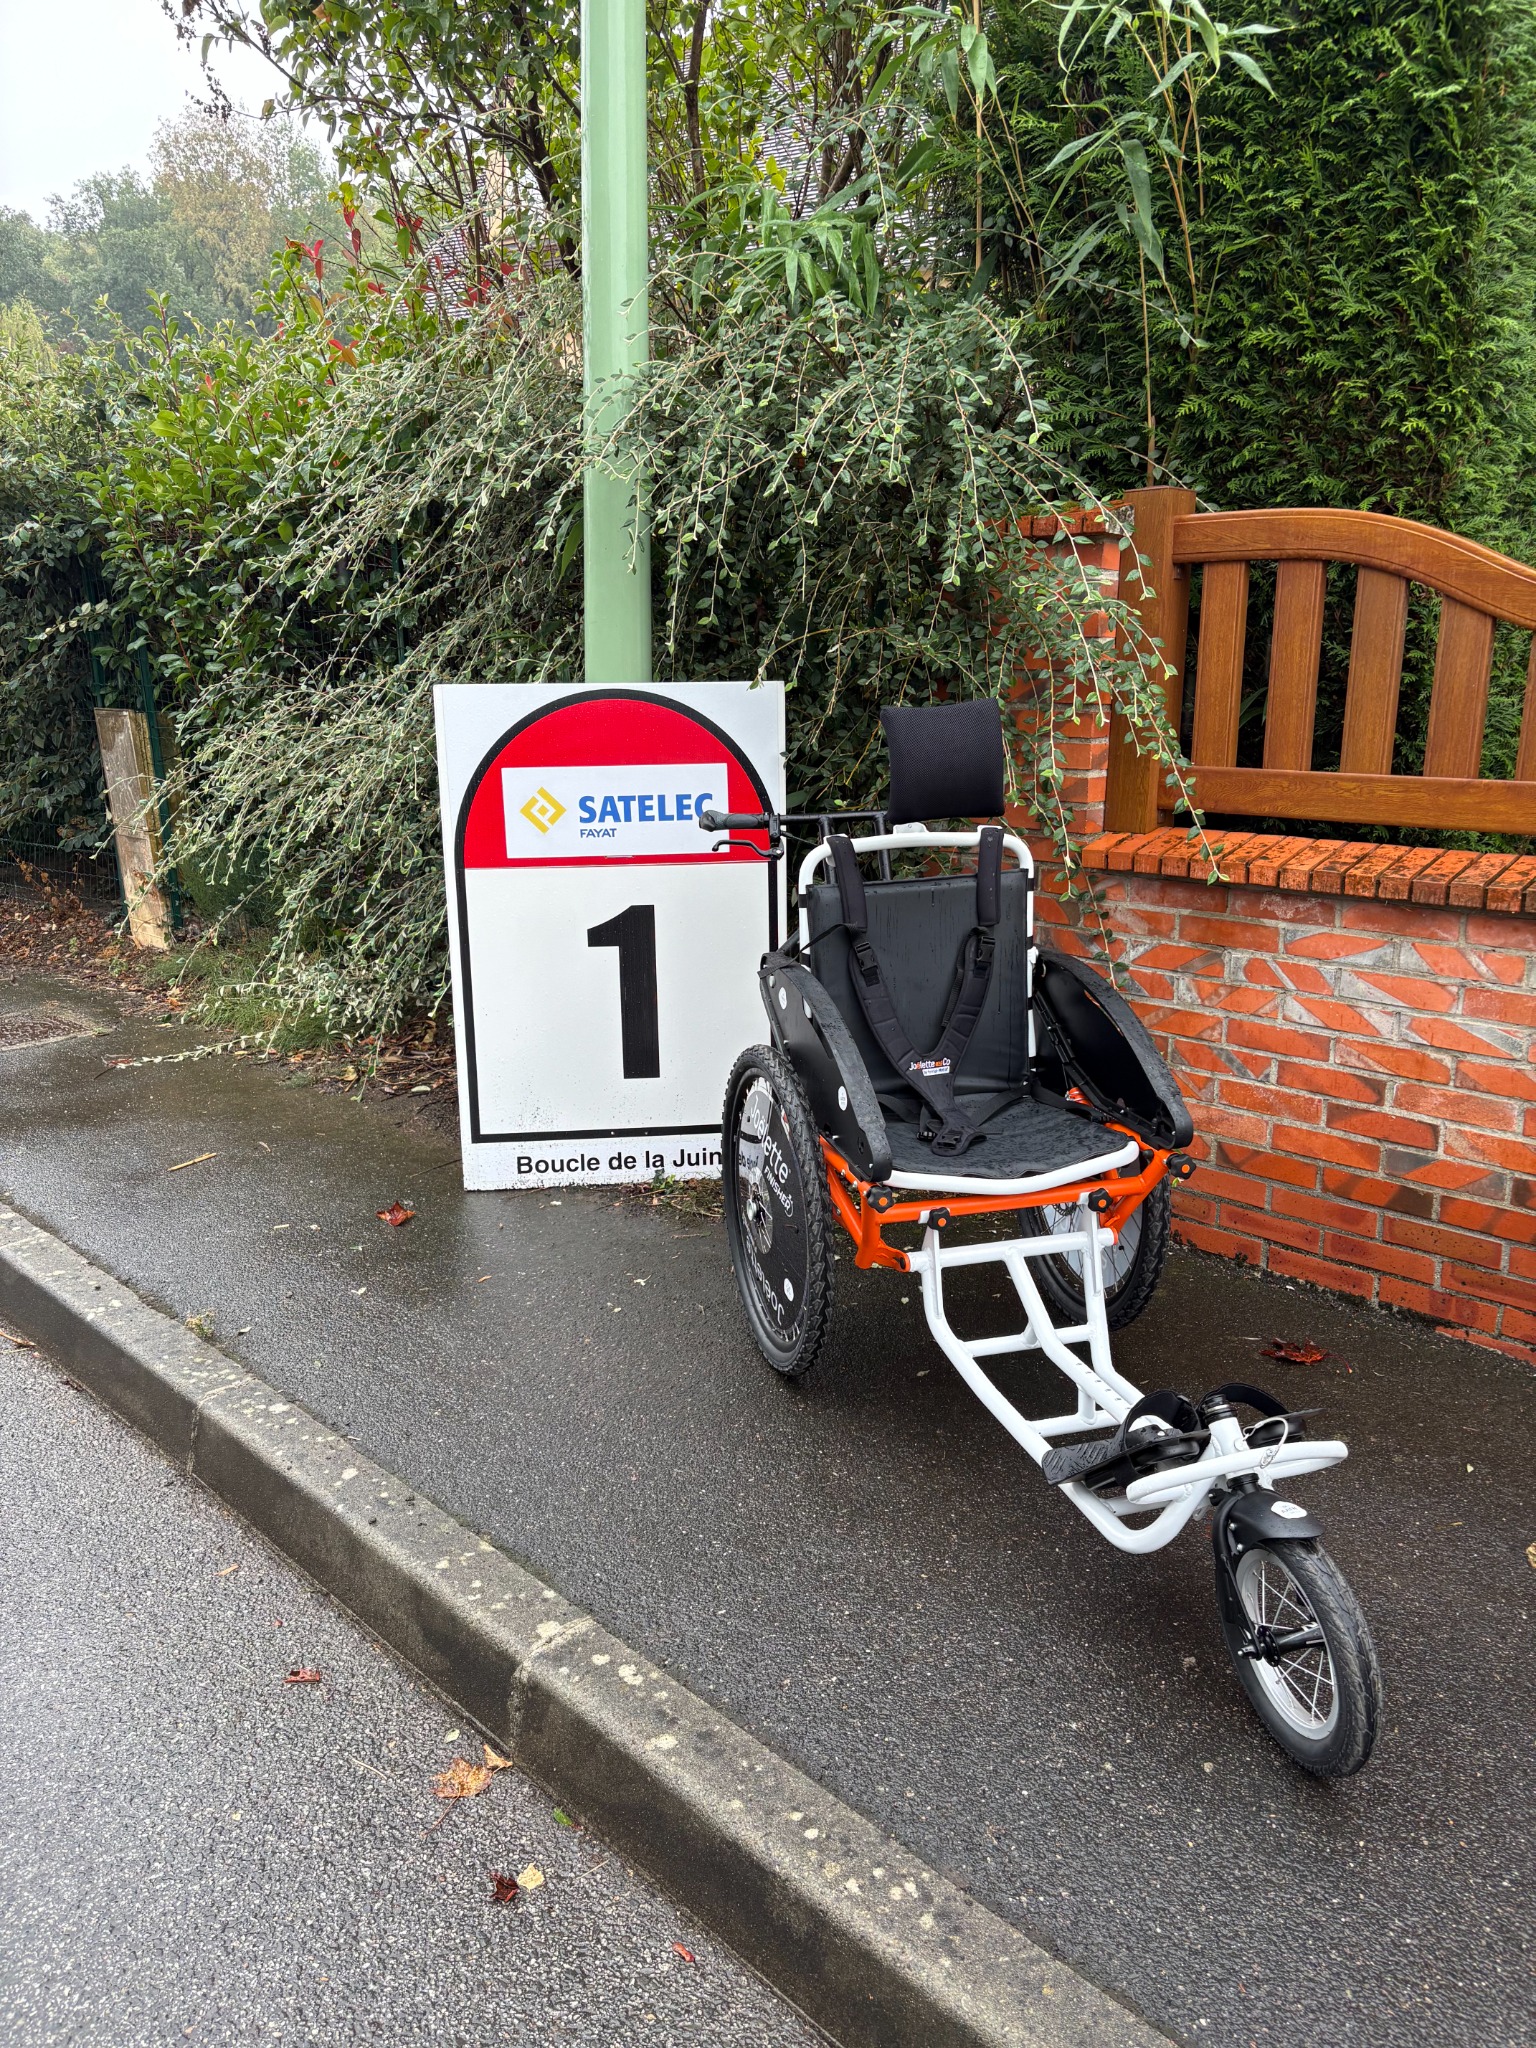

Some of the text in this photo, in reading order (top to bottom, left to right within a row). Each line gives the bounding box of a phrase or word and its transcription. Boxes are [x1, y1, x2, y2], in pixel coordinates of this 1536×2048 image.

[578, 793, 713, 823] SATELEC
[579, 828, 617, 838] FAYAT
[586, 904, 661, 1080] 1
[750, 1094, 789, 1184] Joëlette
[516, 1153, 600, 1174] Boucle
[608, 1151, 637, 1170] de
[645, 1150, 665, 1169] la
[763, 1165, 792, 1211] FINISHER
